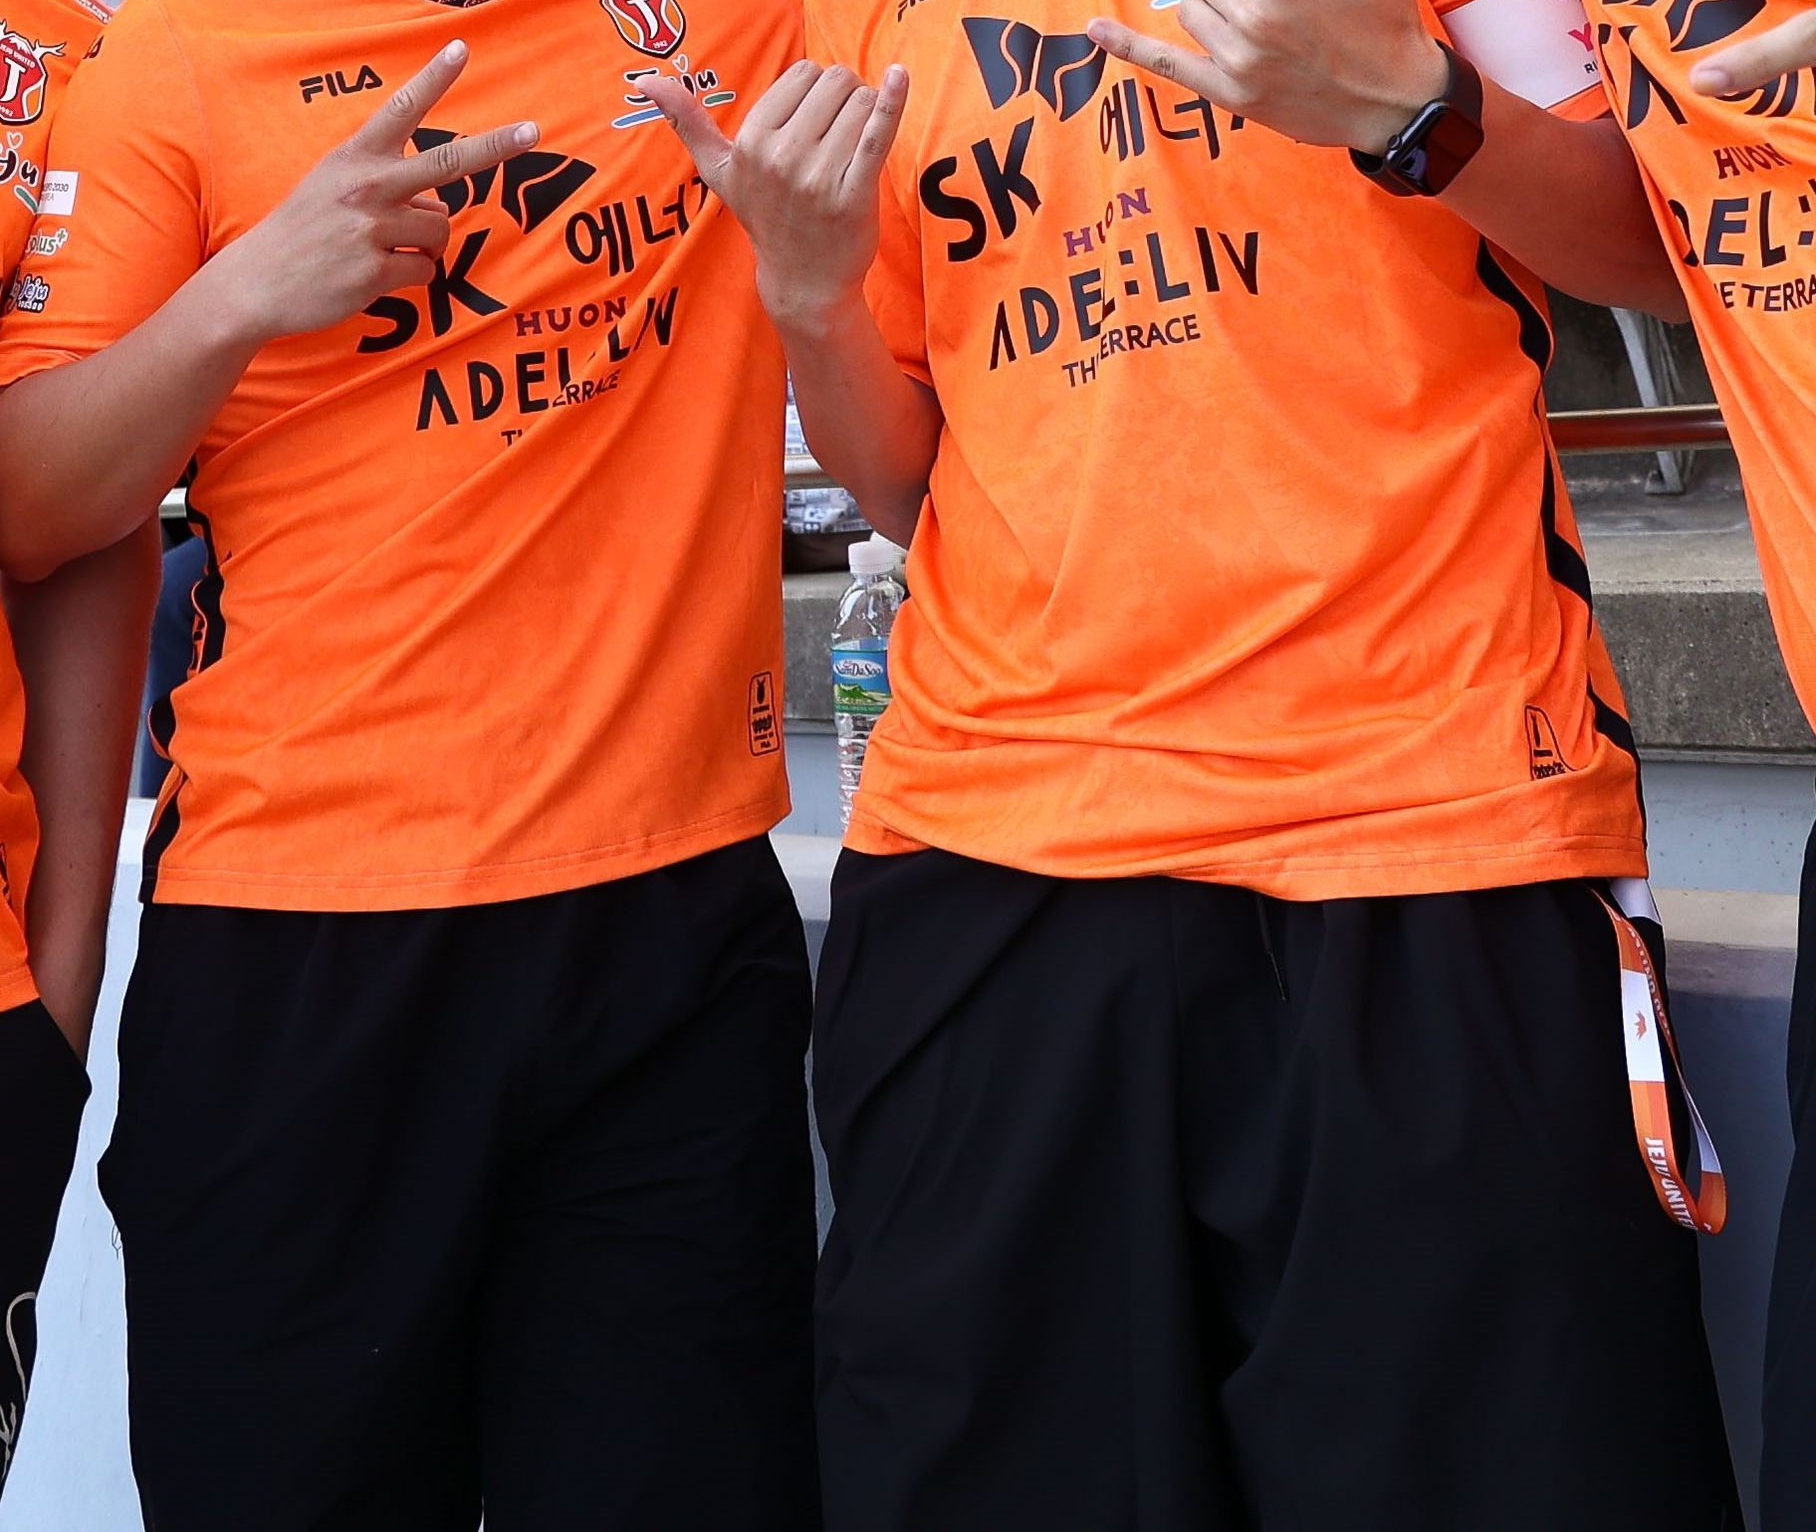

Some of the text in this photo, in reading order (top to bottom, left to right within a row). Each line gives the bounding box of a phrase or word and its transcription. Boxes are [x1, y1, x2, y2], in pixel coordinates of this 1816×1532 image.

[299, 65, 383, 104] FILA
[1100, 77, 1248, 161] 에너
[919, 115, 1042, 263] SK
[1713, 142, 1792, 180] HUON
[564, 173, 711, 277] 에너
[515, 295, 627, 337] HUON
[1062, 313, 1201, 388] TH ERRACE
[1645, 1137, 1671, 1177] JEJU
